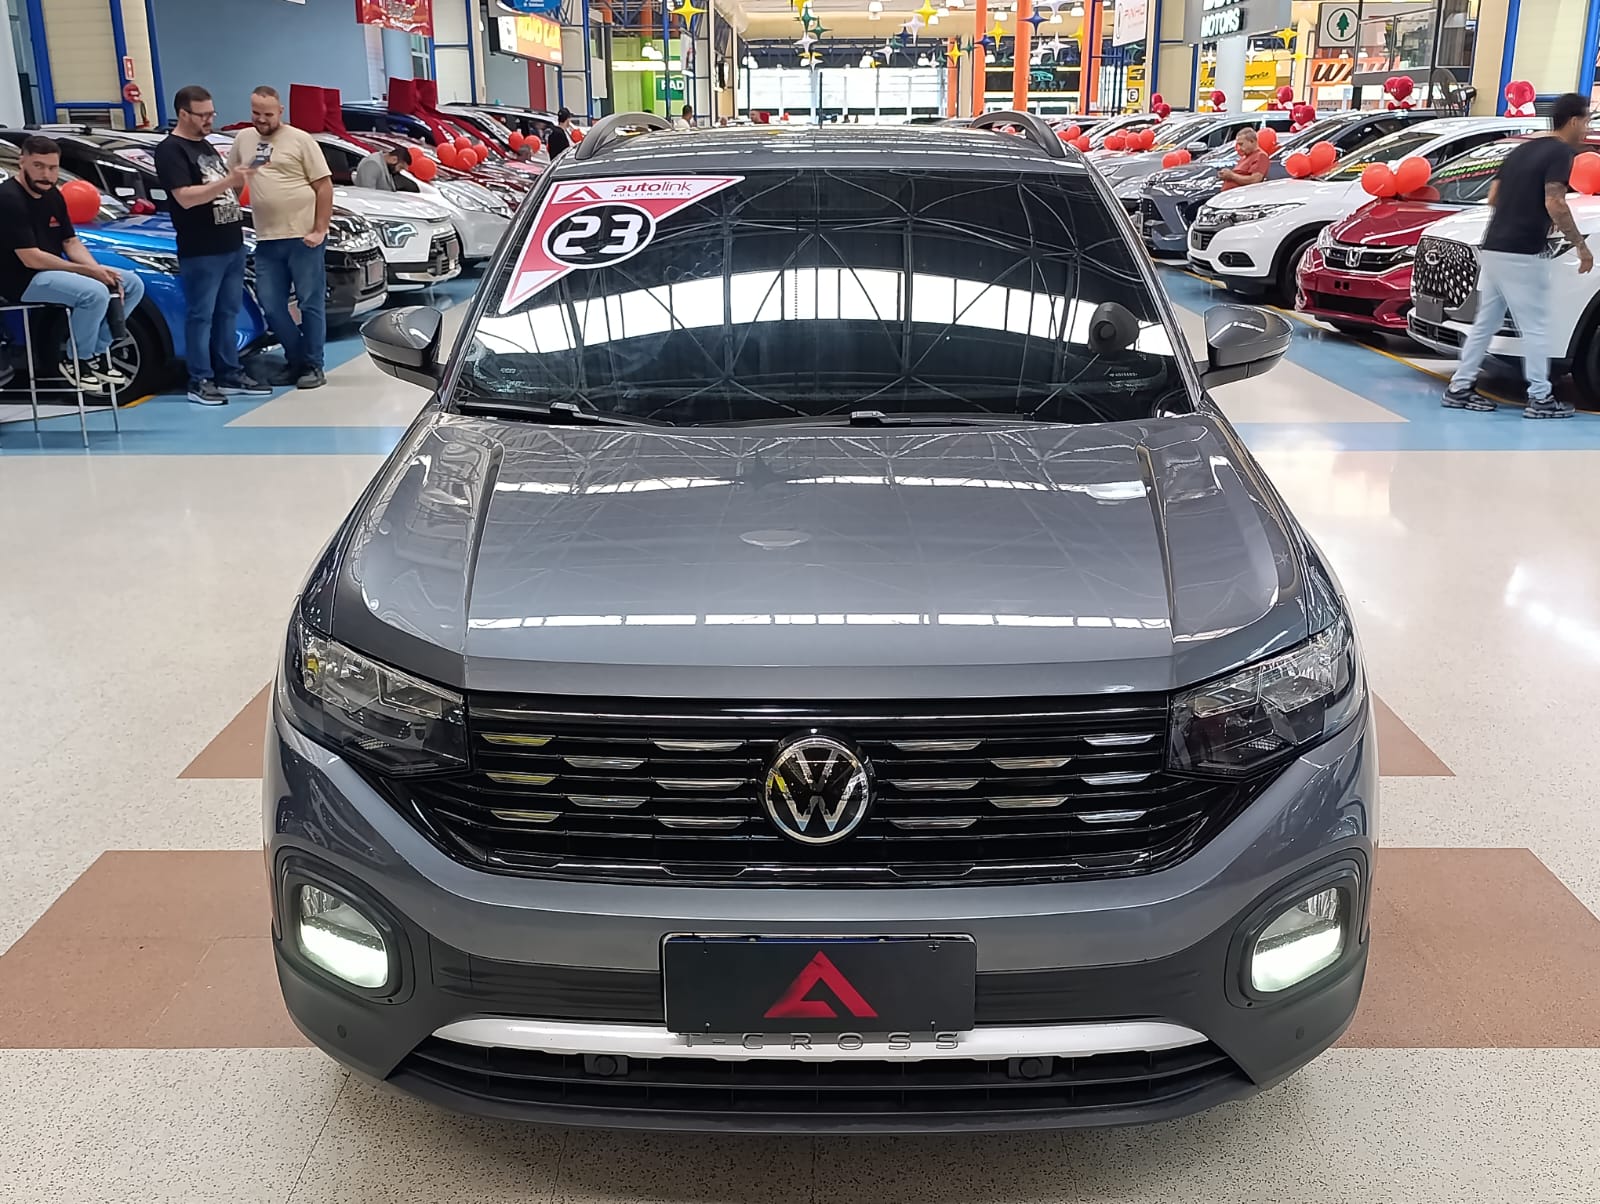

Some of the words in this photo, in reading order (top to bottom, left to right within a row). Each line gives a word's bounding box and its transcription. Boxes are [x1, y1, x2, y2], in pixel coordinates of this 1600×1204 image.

[1201, 7, 1241, 38] MOTORS
[613, 181, 693, 193] autolink
[552, 213, 644, 256] 23
[679, 1032, 960, 1051] T-CROSS
